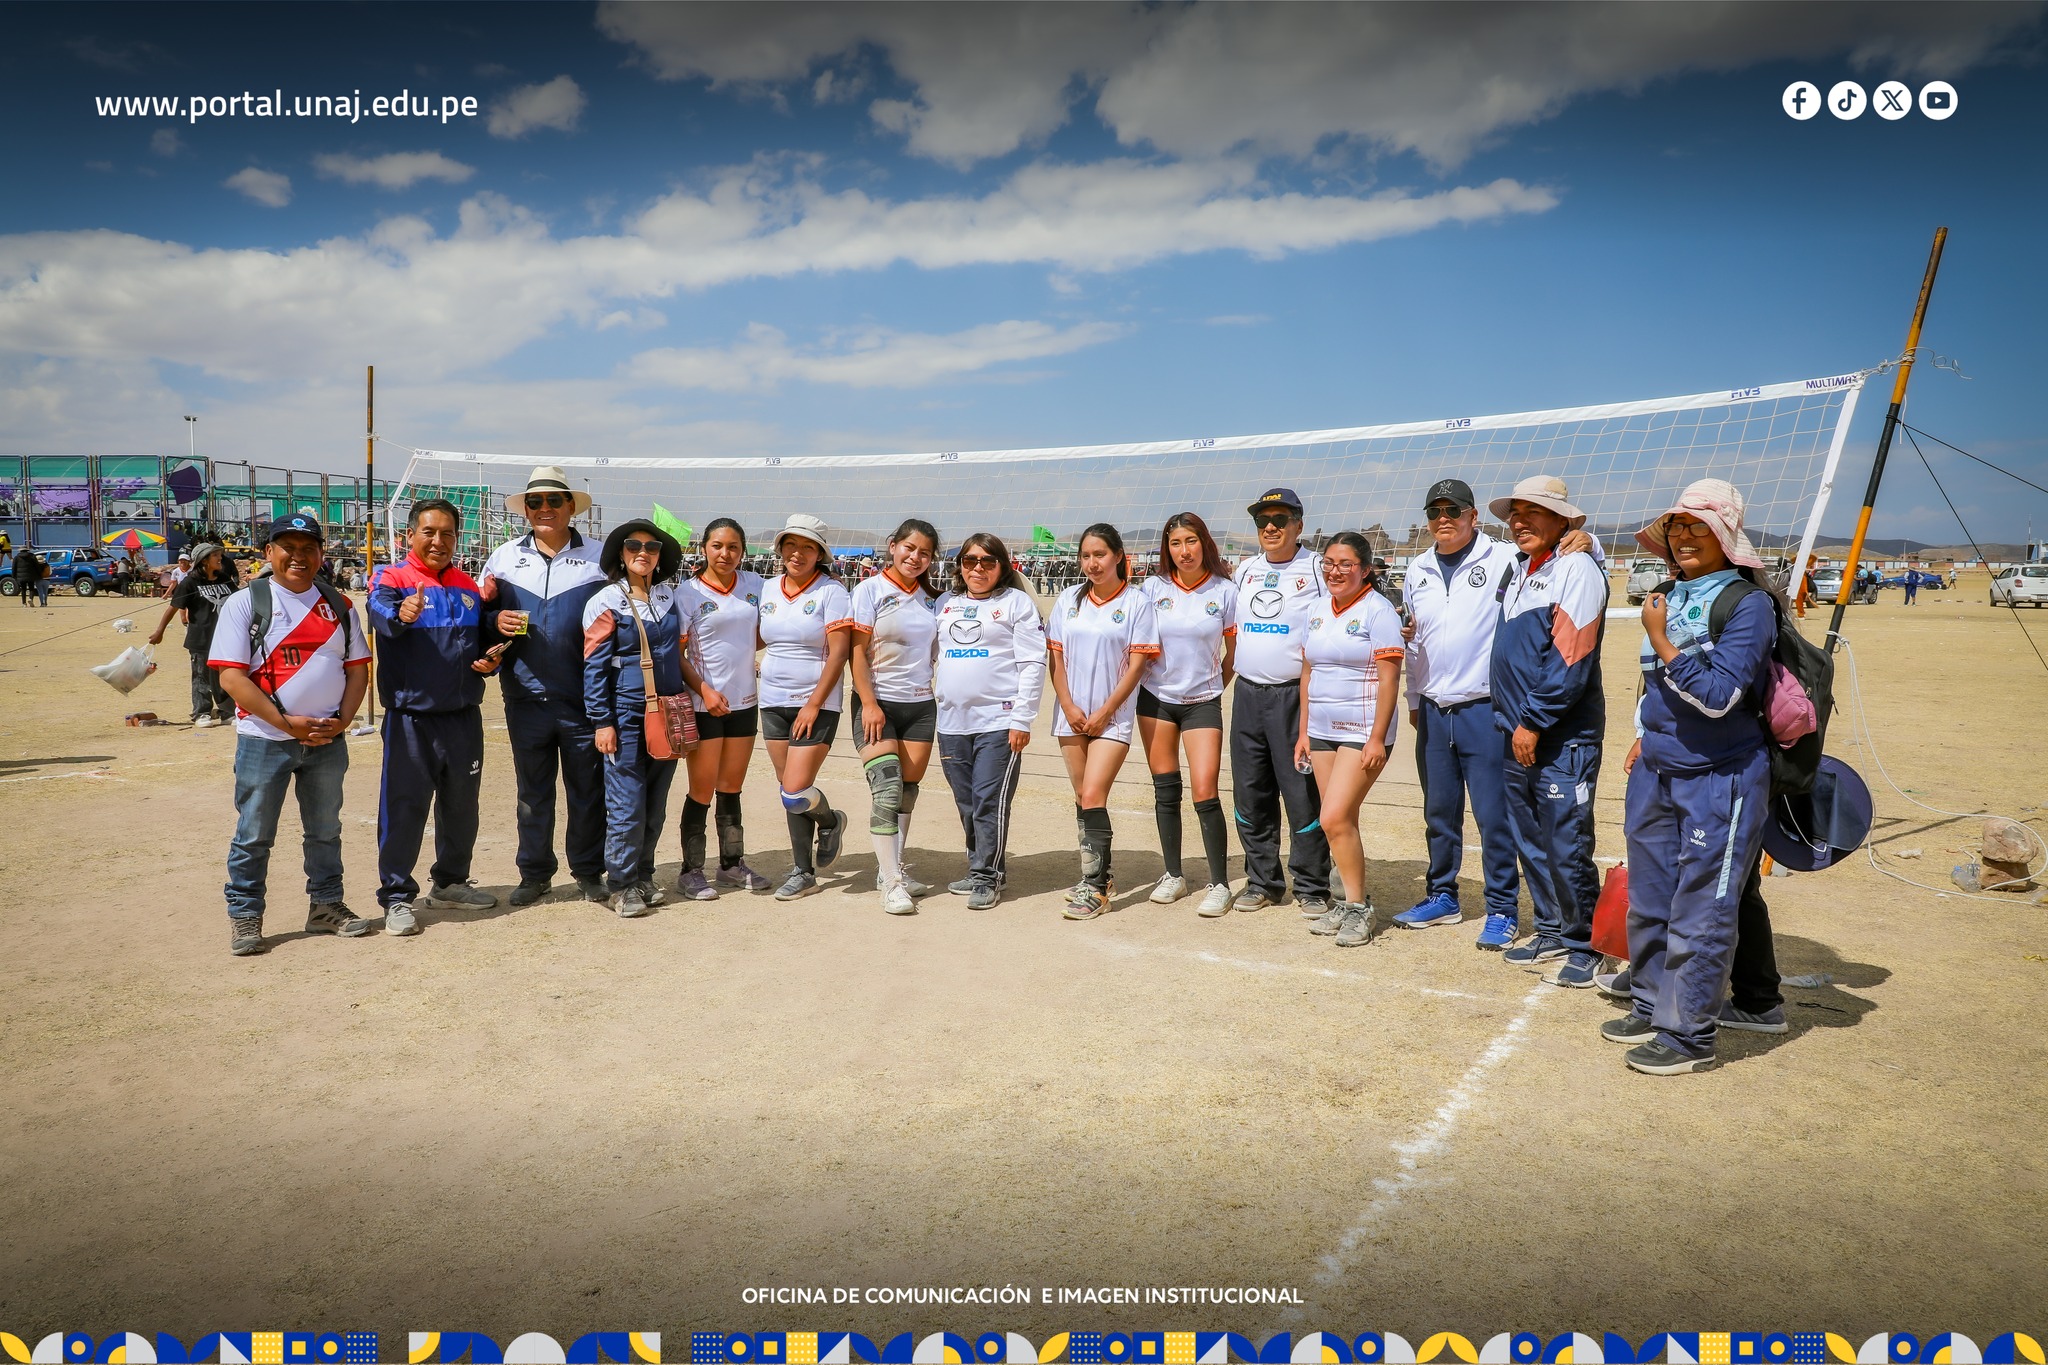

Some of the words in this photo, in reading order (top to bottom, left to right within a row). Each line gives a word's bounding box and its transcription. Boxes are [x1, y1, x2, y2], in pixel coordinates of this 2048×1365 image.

[1445, 418, 1471, 429] FIVB
[1192, 438, 1215, 448] FIVB
[940, 452, 959, 460] FIVB
[280, 646, 301, 667] 10
